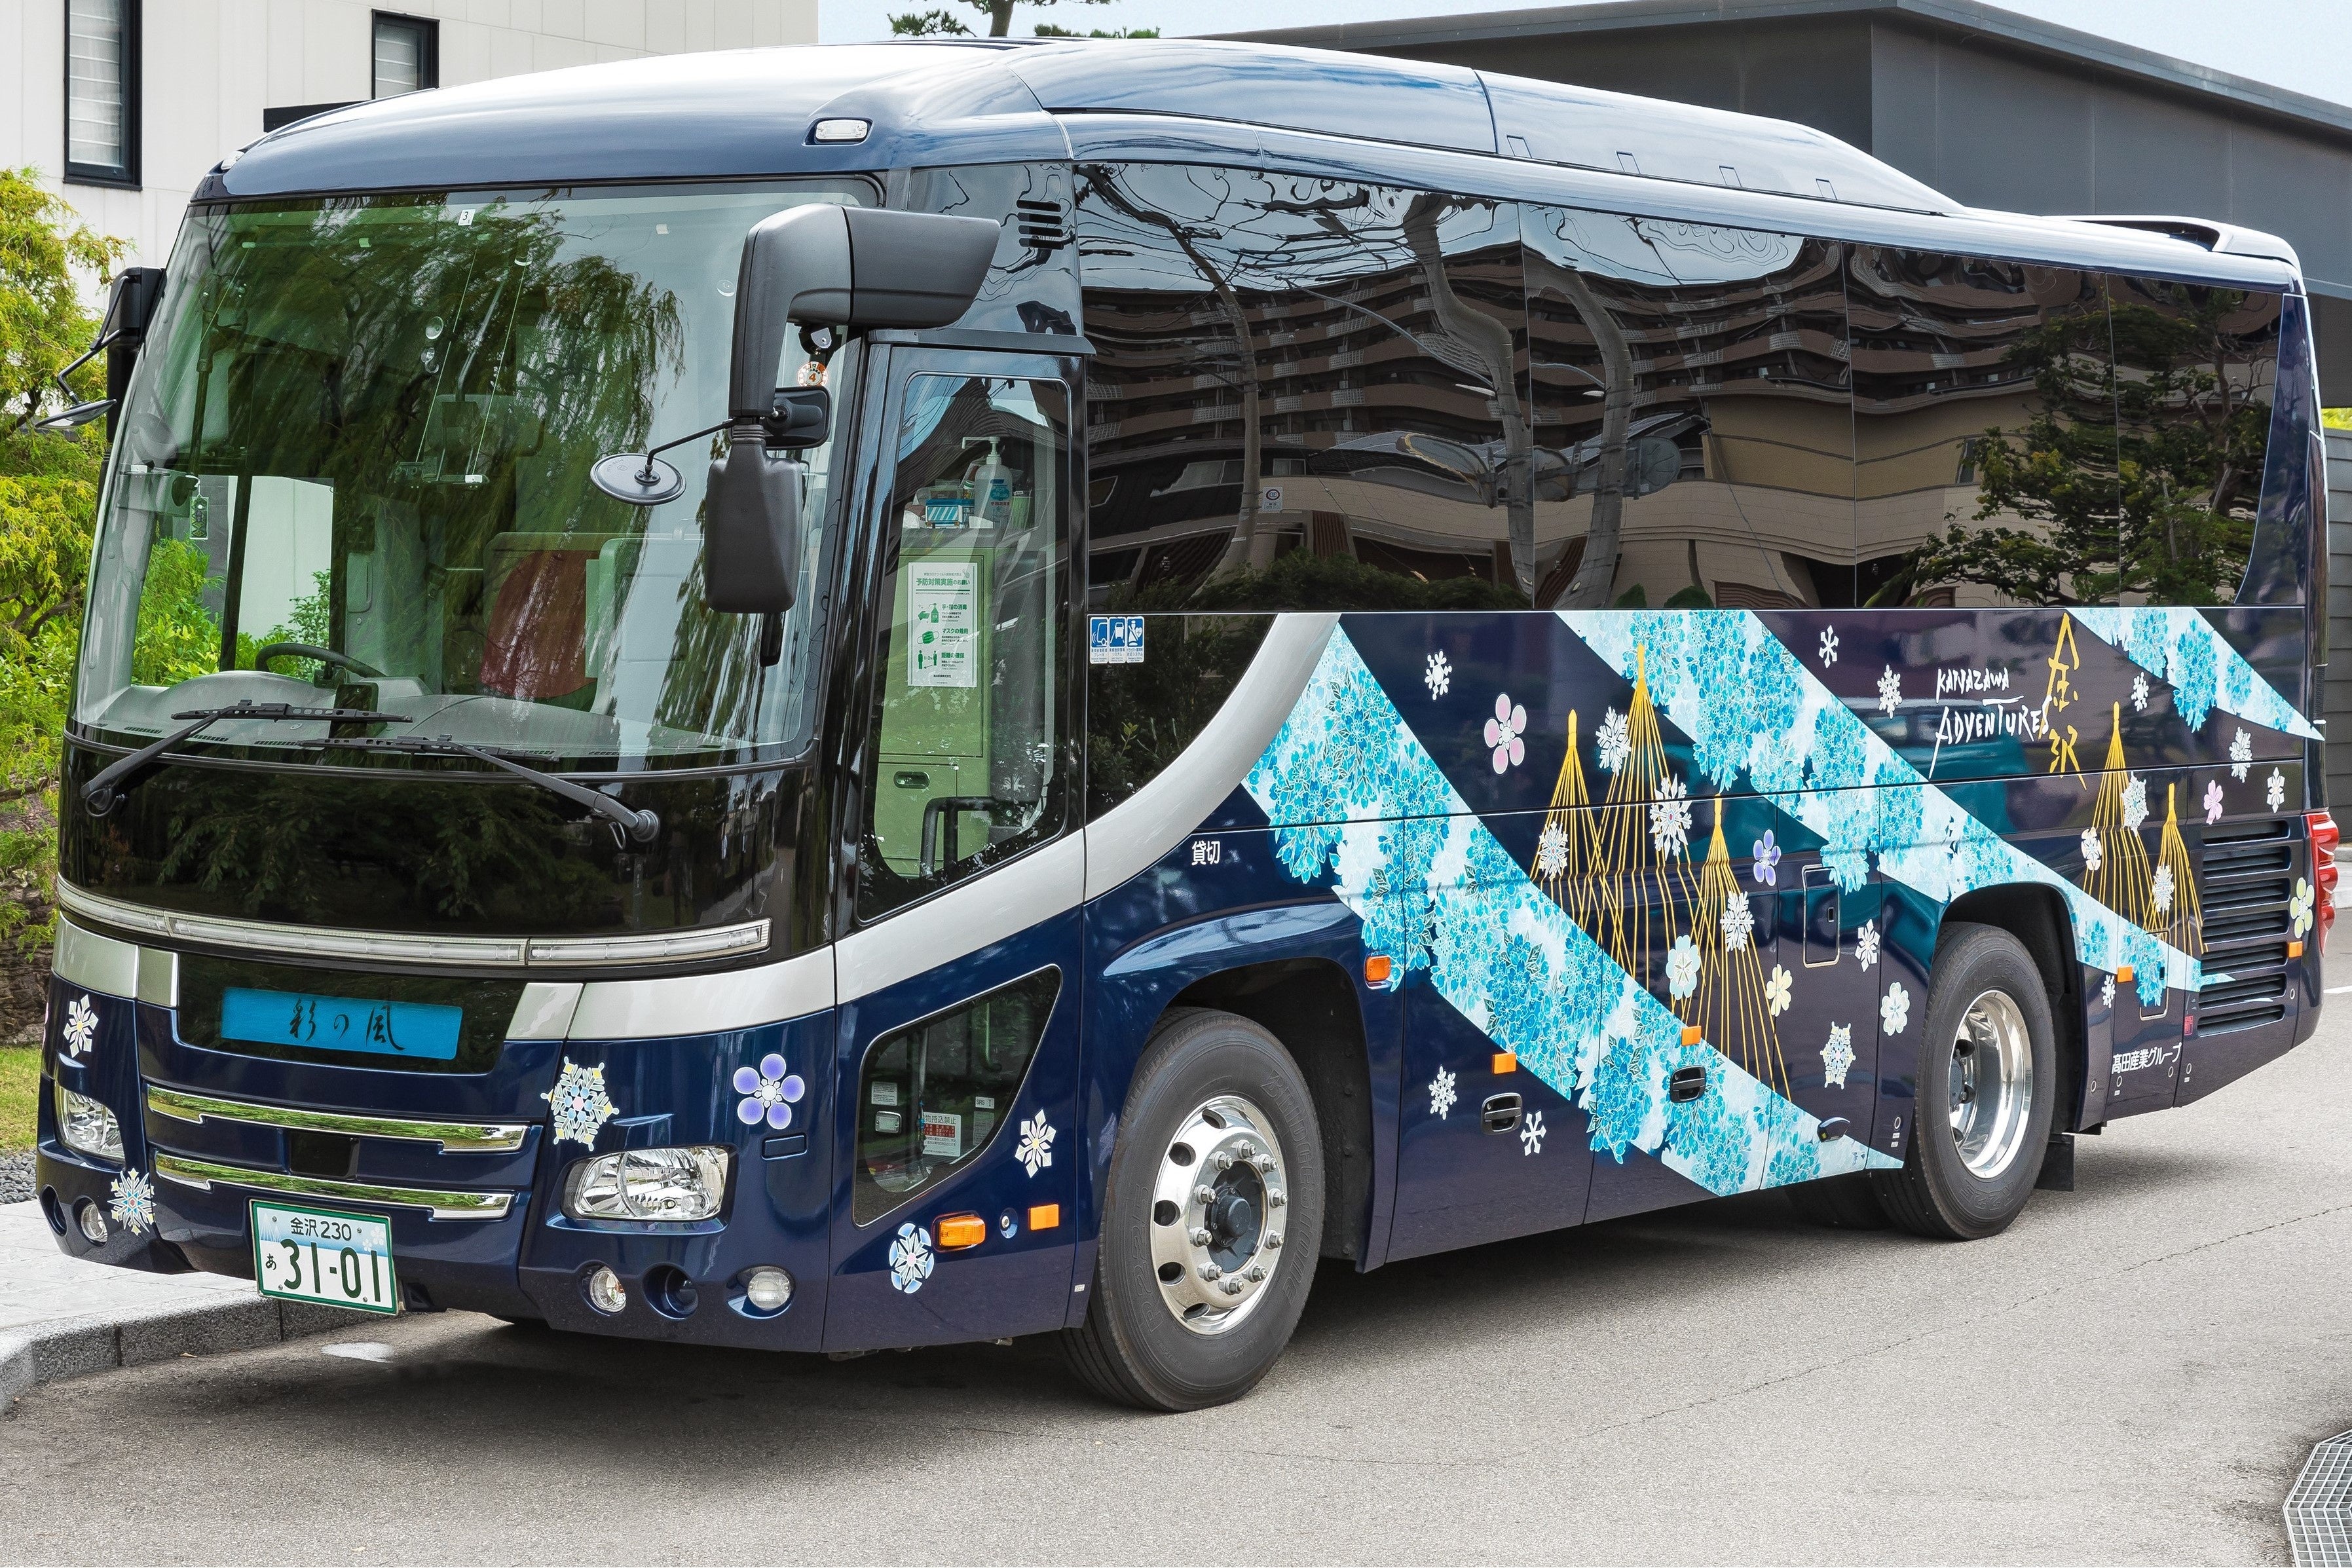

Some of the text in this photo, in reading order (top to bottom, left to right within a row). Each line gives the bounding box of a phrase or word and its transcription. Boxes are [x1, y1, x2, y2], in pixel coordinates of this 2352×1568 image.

[462, 211, 469, 221] 3
[808, 373, 816, 382] 4
[1191, 840, 1220, 865] 貸切
[289, 998, 407, 1051] 彩の風
[1260, 1069, 1316, 1306] BRIDGESTONE
[290, 1216, 352, 1242] 金沢230
[265, 1238, 381, 1303] あ 31-01
